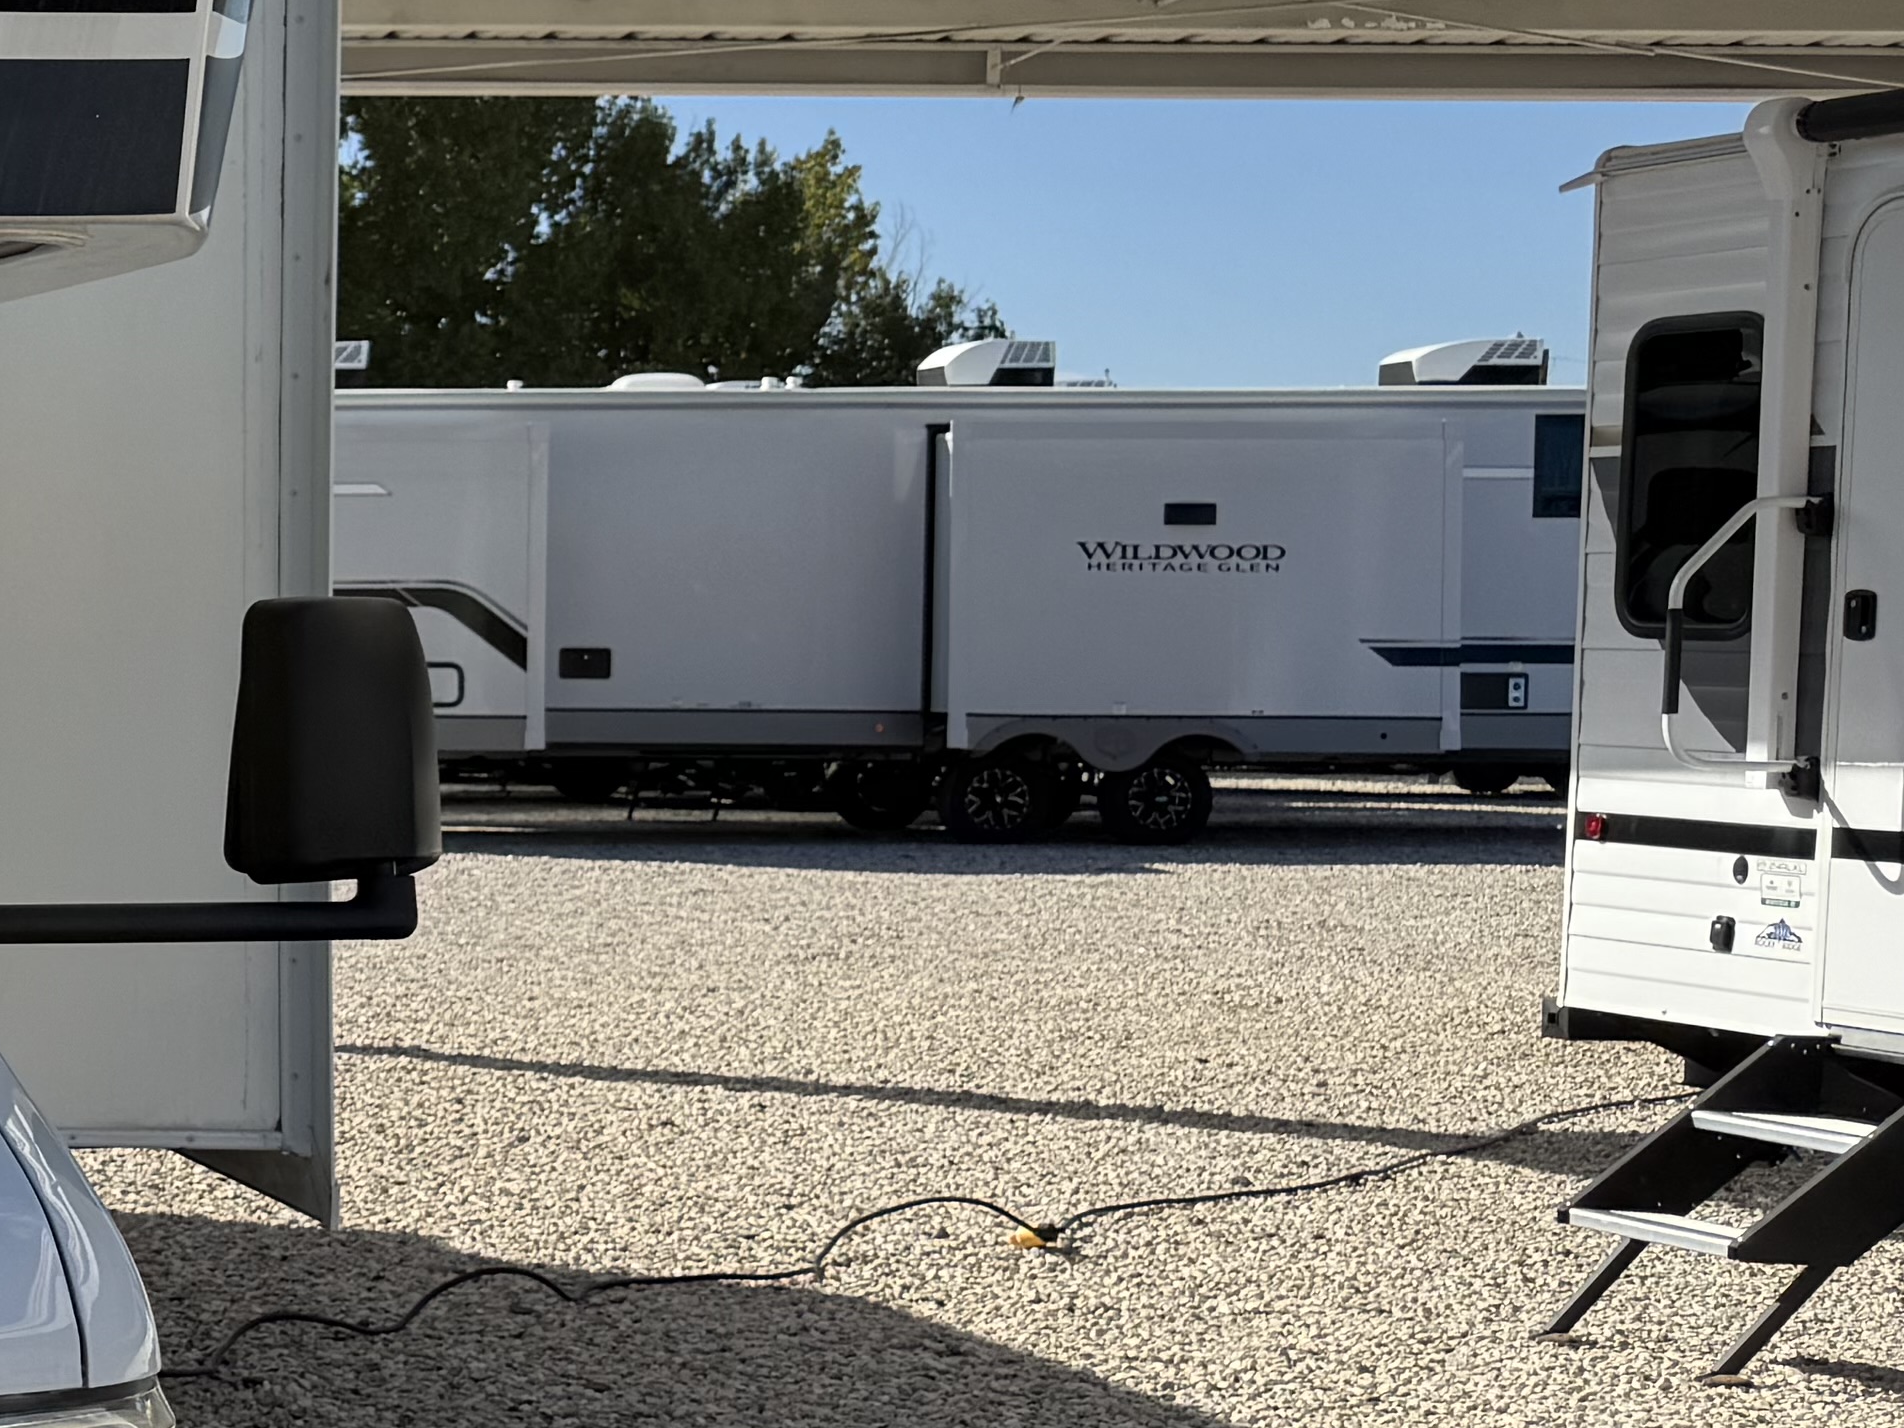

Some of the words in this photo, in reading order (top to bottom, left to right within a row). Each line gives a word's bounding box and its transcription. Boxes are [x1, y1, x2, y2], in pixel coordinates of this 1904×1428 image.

[1076, 541, 1287, 561] WILDWOOD
[1087, 561, 1208, 573] HERITAGE
[1218, 561, 1280, 573] GLEN
